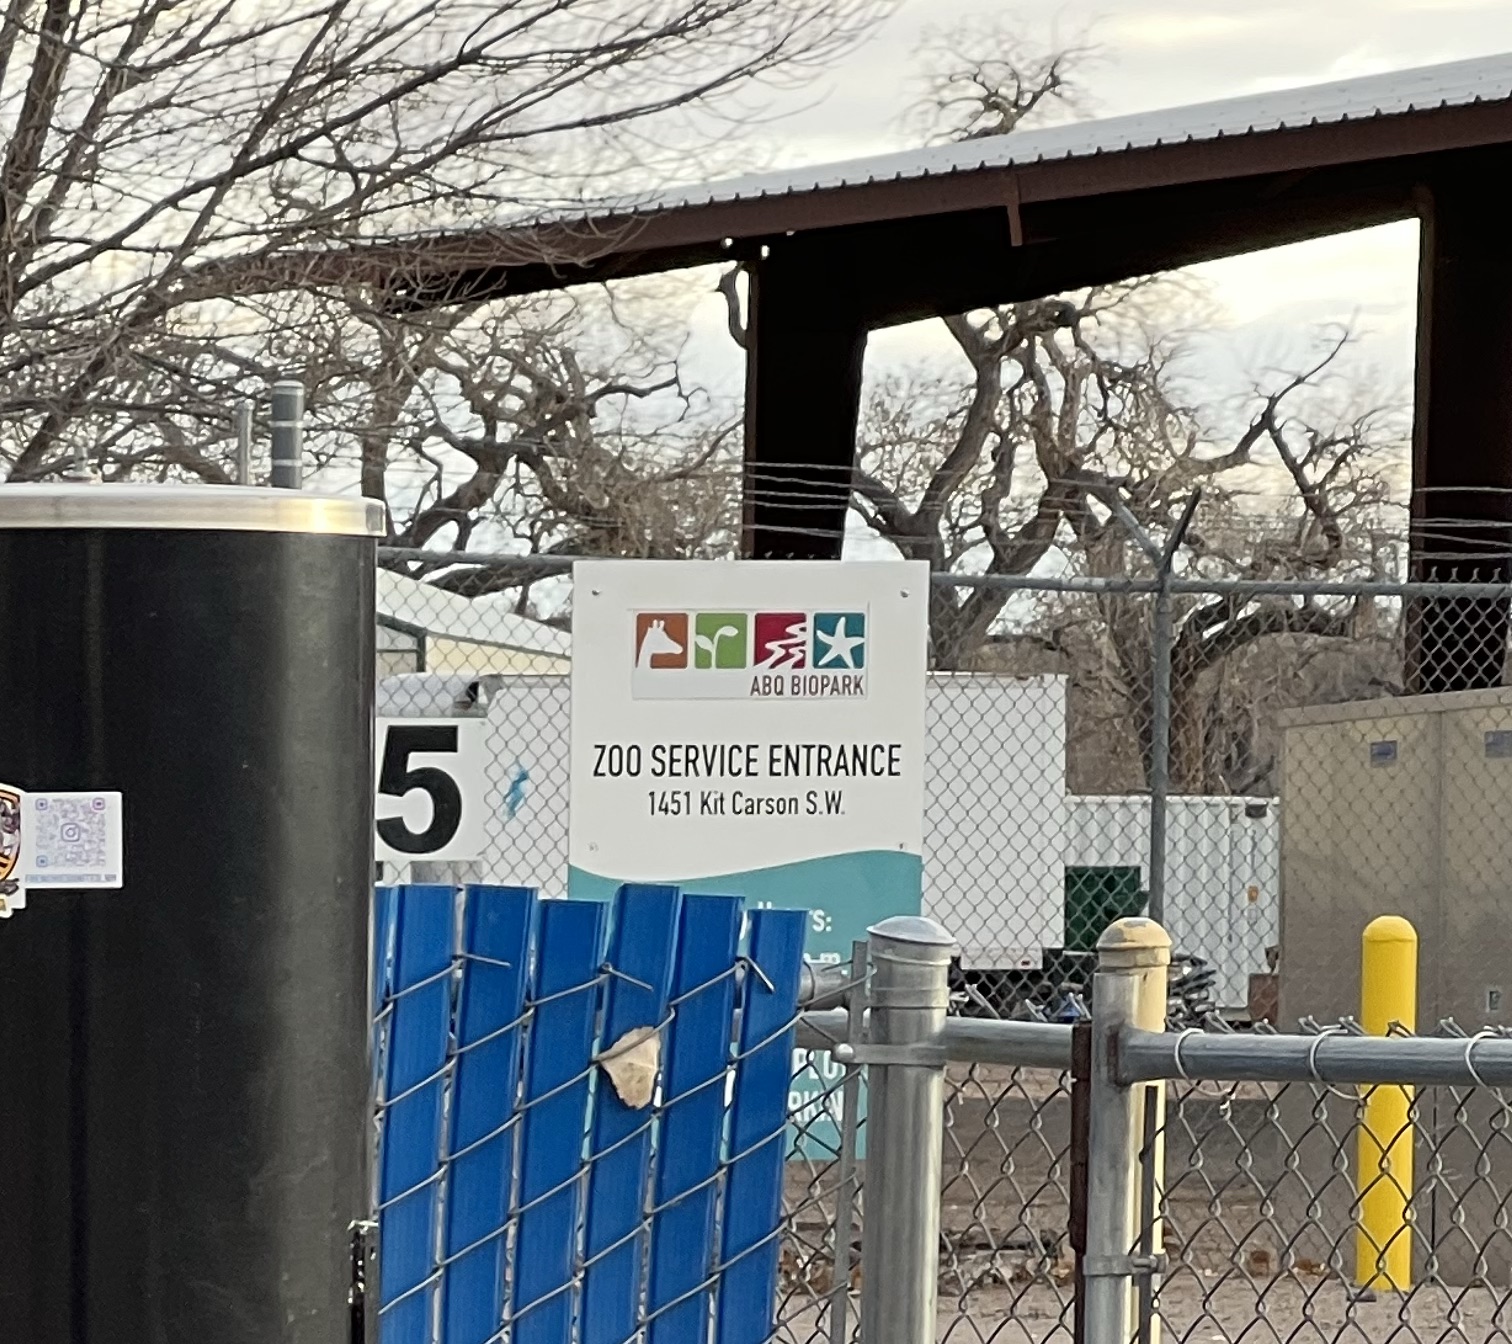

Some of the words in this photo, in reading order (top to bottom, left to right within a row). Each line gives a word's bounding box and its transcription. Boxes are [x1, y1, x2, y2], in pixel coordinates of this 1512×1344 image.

[749, 674, 785, 697] ABQ
[791, 674, 865, 697] BIOPARK
[592, 743, 642, 778] ZOO
[650, 743, 761, 778] SERVICE
[769, 743, 902, 778] ENTRANCE
[647, 790, 692, 816] 1451
[700, 790, 727, 816] Kit
[732, 790, 800, 816] Carson
[806, 790, 845, 816] S.W.
